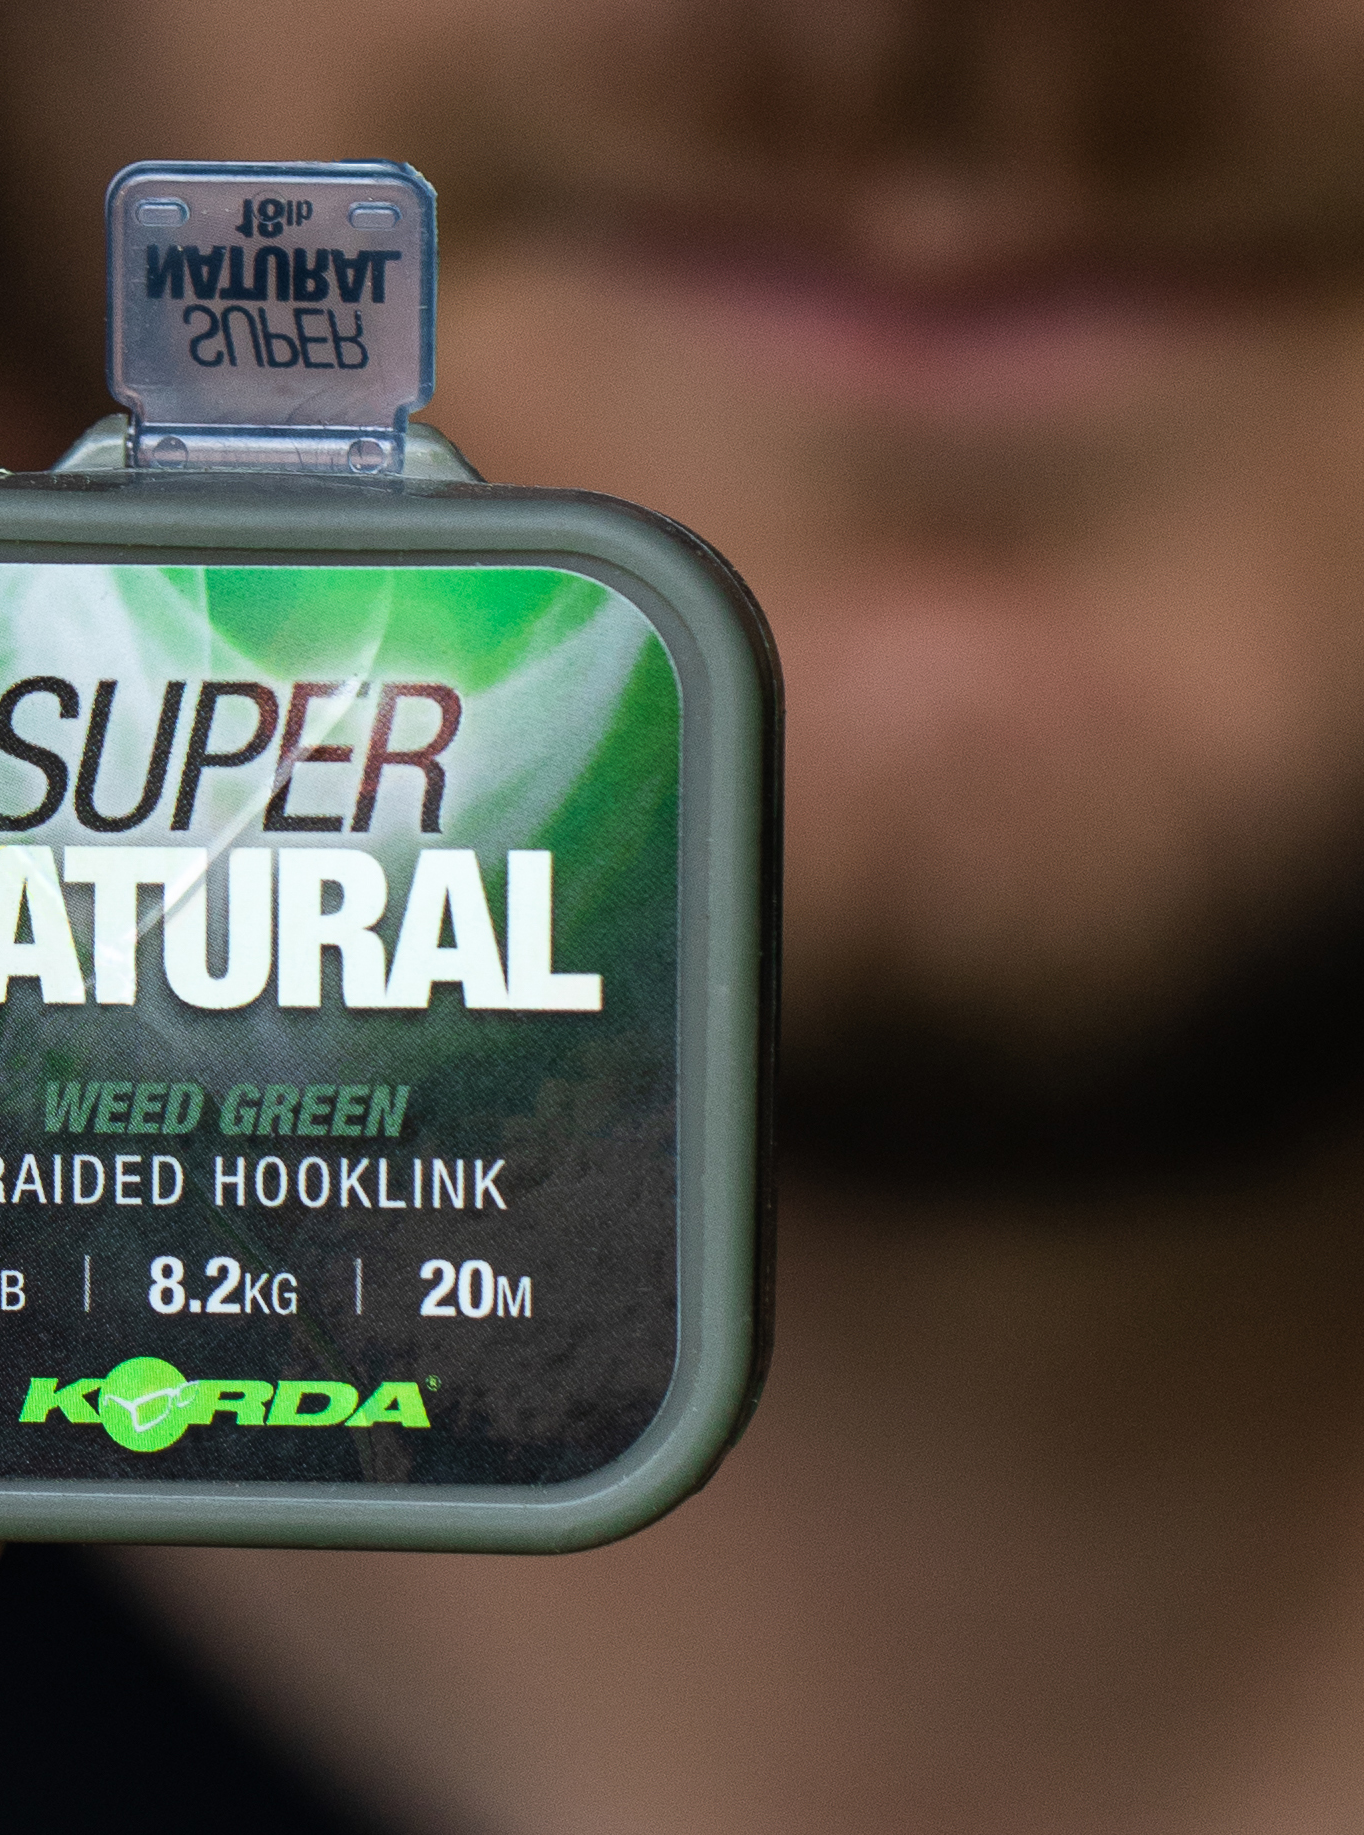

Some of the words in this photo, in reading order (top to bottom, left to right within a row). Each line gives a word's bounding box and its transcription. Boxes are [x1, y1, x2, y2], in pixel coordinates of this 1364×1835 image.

[43, 1080, 204, 1136] WEED
[219, 1083, 411, 1138] GREEN
[213, 1155, 508, 1210] HOOKLINK
[147, 1255, 299, 1316] 8.2KG
[419, 1258, 533, 1319] 20M
[18, 1356, 431, 1453] KORDA
